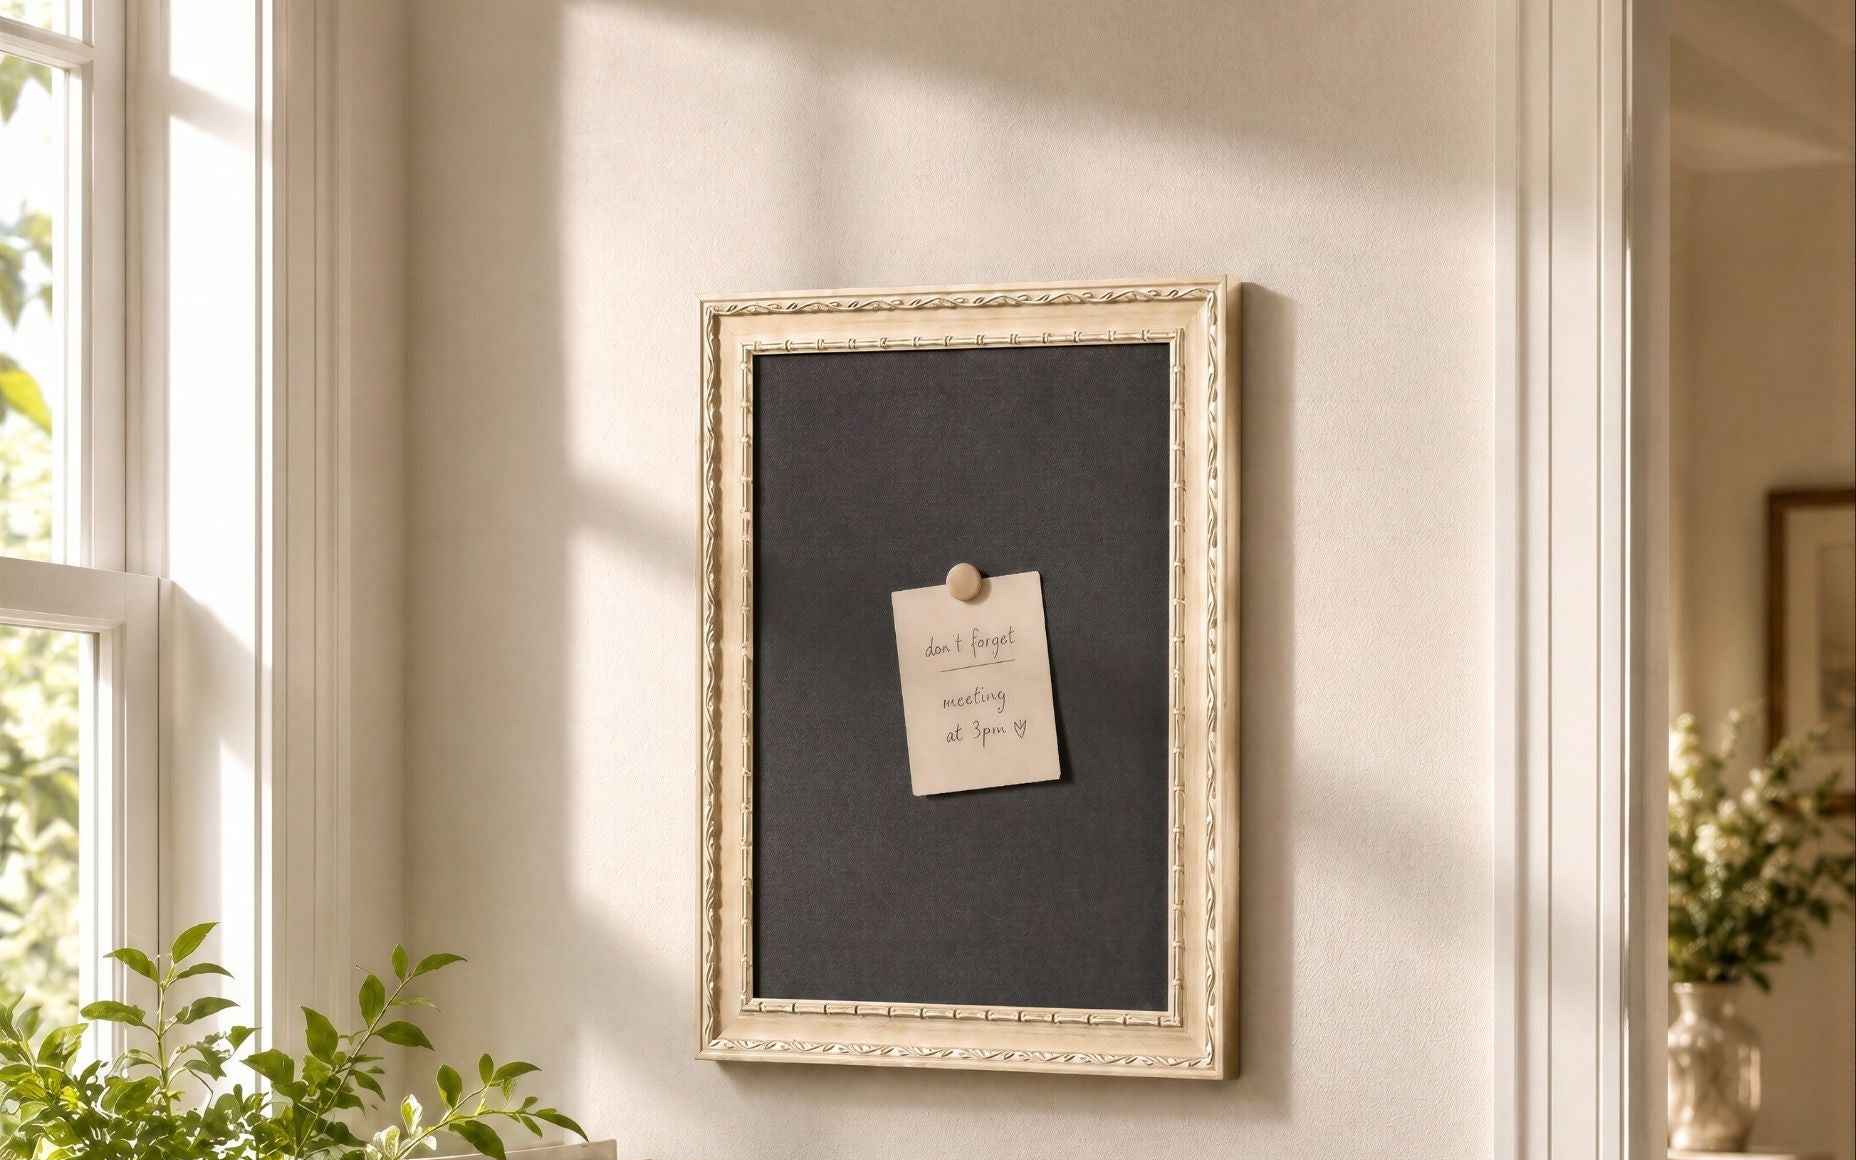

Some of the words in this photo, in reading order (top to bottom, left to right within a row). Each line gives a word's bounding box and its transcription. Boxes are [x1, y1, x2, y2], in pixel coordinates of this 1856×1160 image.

[971, 625, 1016, 659] forget
[943, 686, 1007, 714] meeting
[945, 723, 962, 744] at
[972, 720, 1007, 748] 3pm
